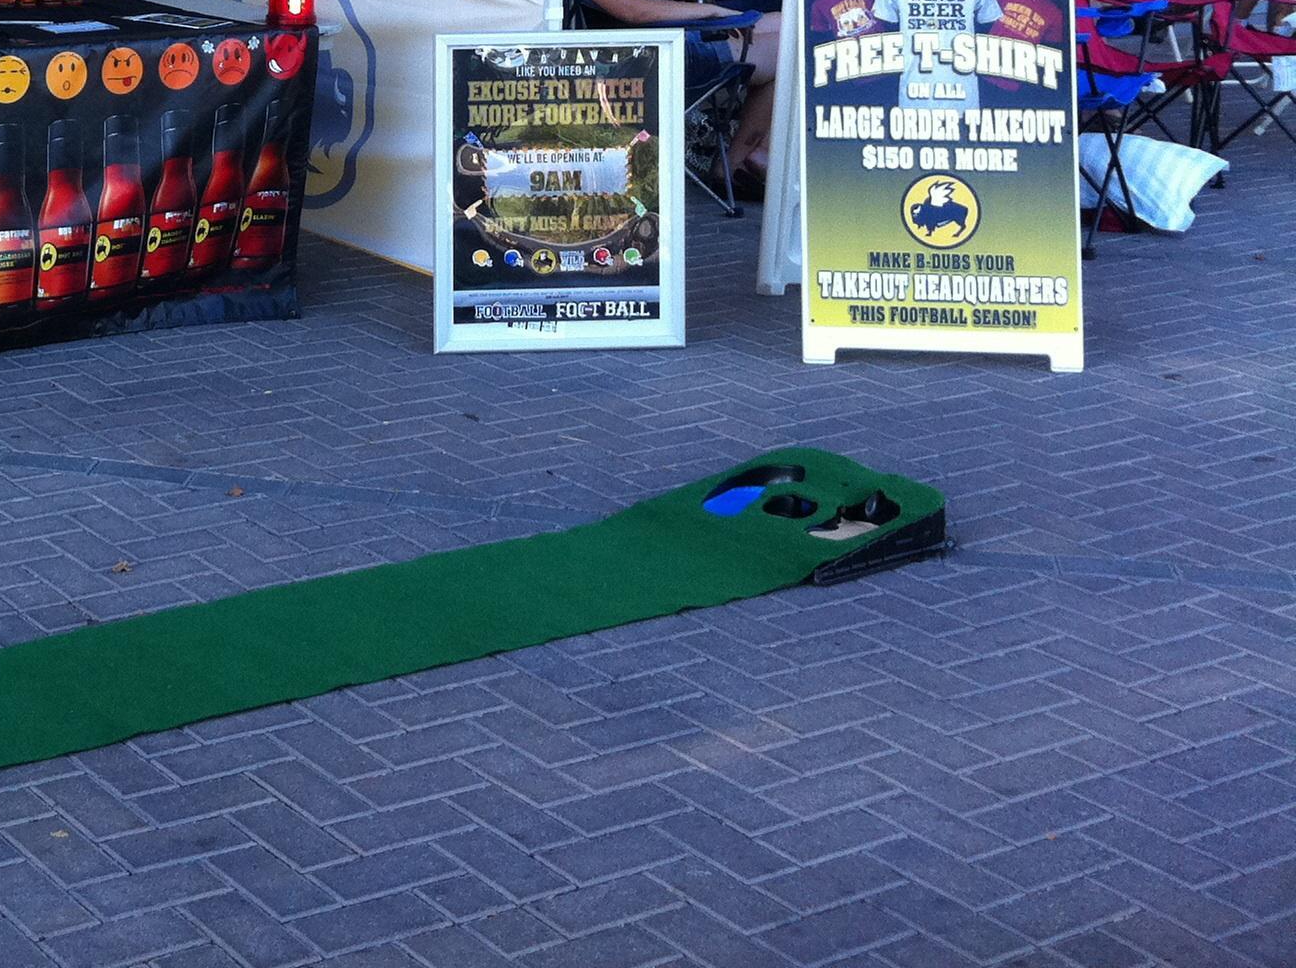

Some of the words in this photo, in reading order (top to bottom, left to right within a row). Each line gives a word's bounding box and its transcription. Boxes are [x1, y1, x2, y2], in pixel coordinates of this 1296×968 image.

[908, 2, 966, 18] BEER
[516, 66, 536, 77] LIKE
[538, 66, 554, 77] YOU
[558, 65, 582, 76] NEED
[584, 65, 596, 76] AN
[813, 32, 905, 88] FREE
[913, 32, 1064, 90] T-SHIRT
[467, 80, 540, 102] EXCUSE
[546, 79, 570, 100] TO
[574, 77, 644, 99] WATCH
[907, 82, 932, 99] ON
[933, 82, 966, 100] ALL
[467, 103, 529, 127] MORE
[533, 101, 644, 126] FOOTBALL!
[815, 105, 885, 140] LARGE
[889, 106, 961, 142] ORDER
[964, 108, 1066, 143] TAKEOUT
[507, 153, 533, 164] WE'LL
[537, 152, 548, 163] BE
[550, 152, 590, 163] OPENING
[862, 144, 914, 170] $150
[919, 146, 950, 170] OR
[955, 147, 1018, 172] MORE
[530, 170, 582, 192] 9AM
[529, 215, 567, 231] MISS
[560, 255, 585, 265] WILD
[869, 251, 911, 269] MAKE
[916, 253, 970, 271] B-DUBS
[975, 254, 1015, 272] YOUR
[817, 270, 909, 301] TAKEOUT
[913, 273, 1069, 305] HEADQUARTERS
[475, 301, 547, 320] FOOTBALL
[604, 301, 650, 317] BALL
[849, 305, 886, 323] THIS
[890, 306, 968, 326] FOOTBALL
[973, 309, 1037, 327] SEASON!
